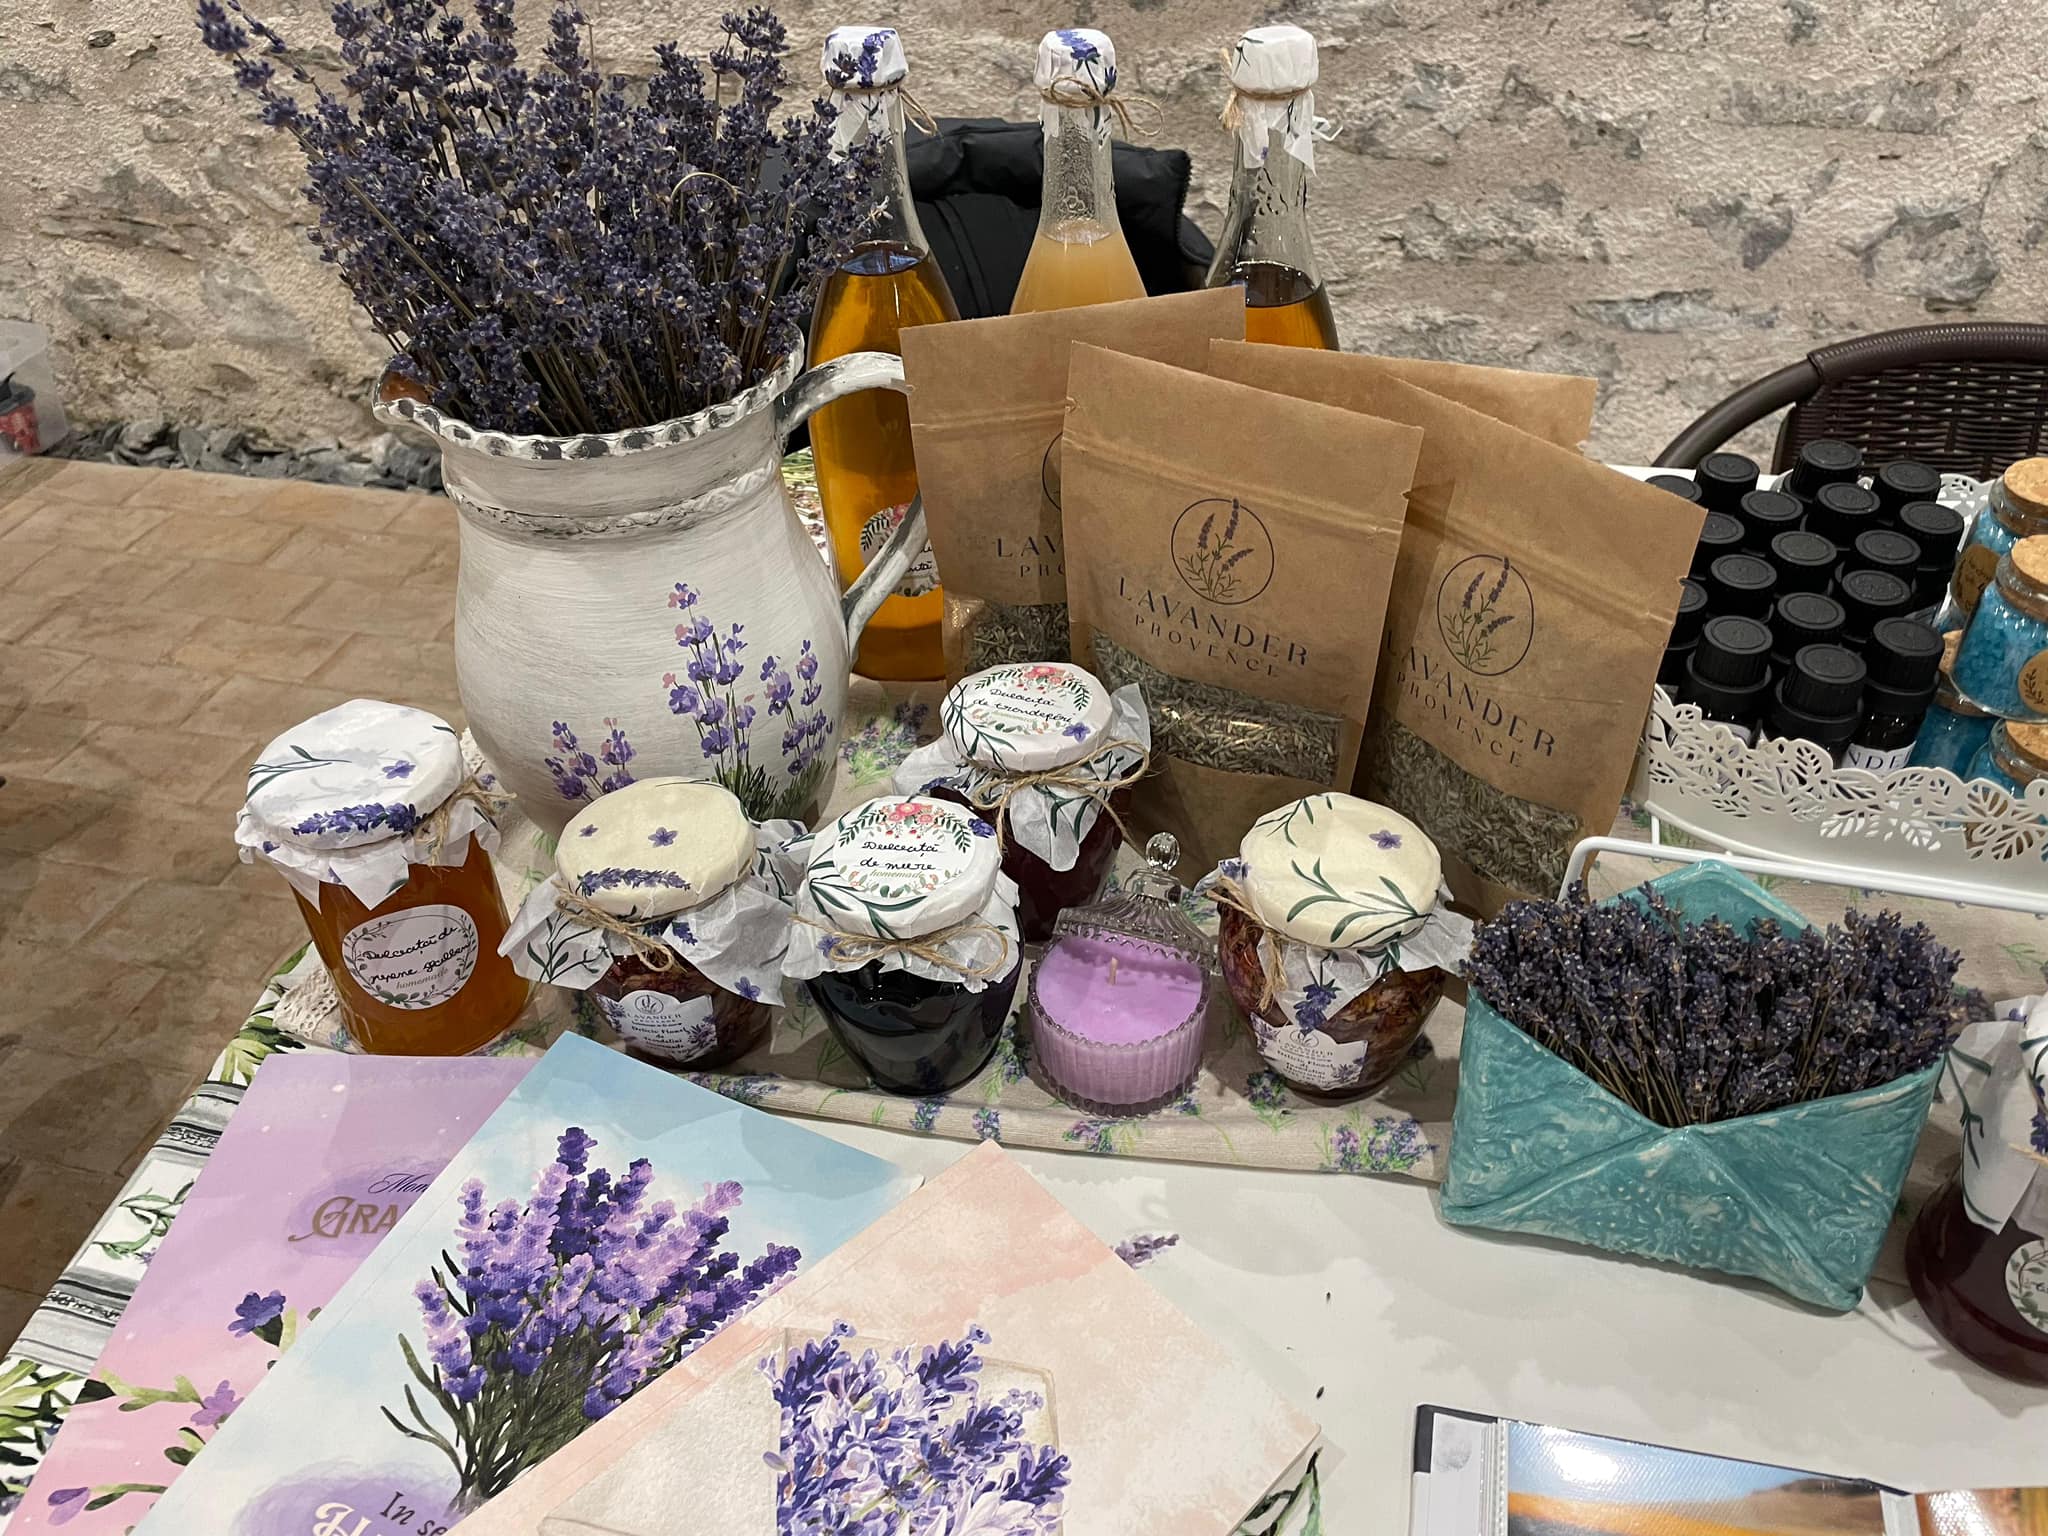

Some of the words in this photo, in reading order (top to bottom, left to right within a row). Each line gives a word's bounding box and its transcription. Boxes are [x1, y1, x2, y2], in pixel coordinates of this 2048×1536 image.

[995, 535, 1063, 559] LAV
[1118, 576, 1309, 666] LAVANDER
[1135, 613, 1280, 678] PROVENCE
[1386, 630, 1556, 757] LAVANDER
[859, 857, 880, 868] de
[884, 862, 937, 871] mure
[869, 868, 926, 879] homemade
[396, 966, 449, 989] homemade
[288, 1196, 399, 1242] GRA
[379, 1490, 416, 1526] In
